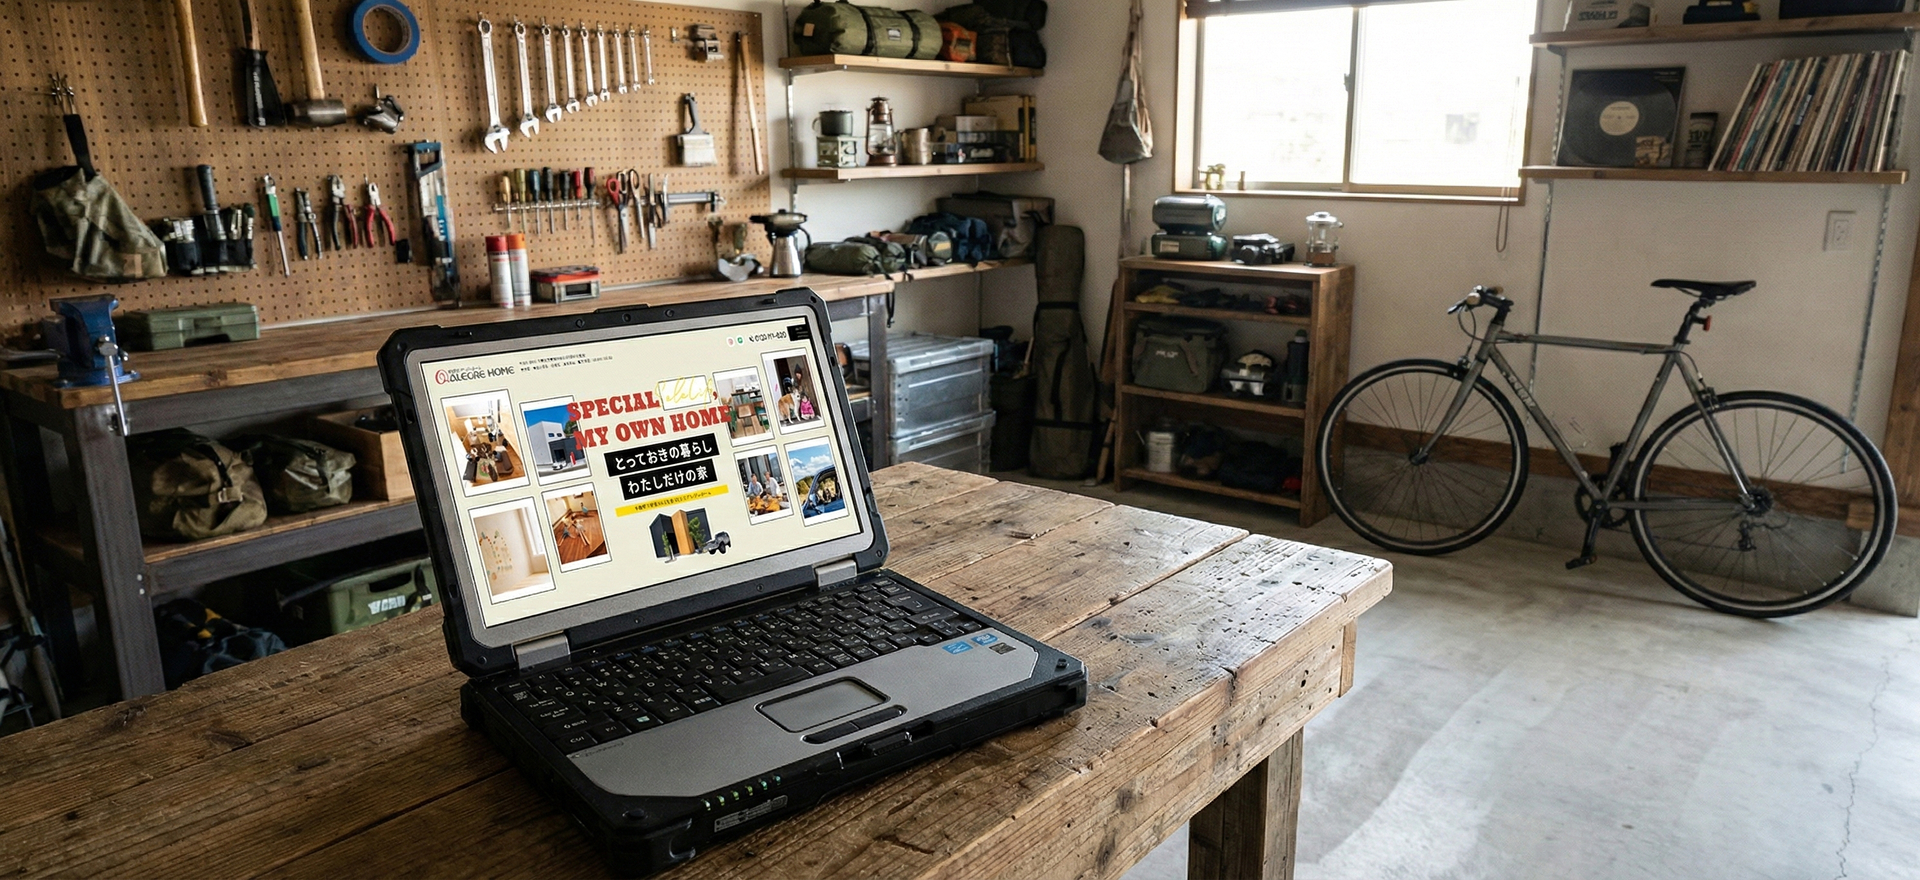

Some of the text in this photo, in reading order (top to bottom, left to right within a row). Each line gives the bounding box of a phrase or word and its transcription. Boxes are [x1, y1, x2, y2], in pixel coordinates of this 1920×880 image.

[488, 365, 515, 378] HOME
[566, 391, 660, 422] SPECIAL
[573, 404, 732, 450] MY OWN HOME
[614, 440, 713, 470] とっておきの暮らし
[627, 465, 709, 495] わたしだけの家
